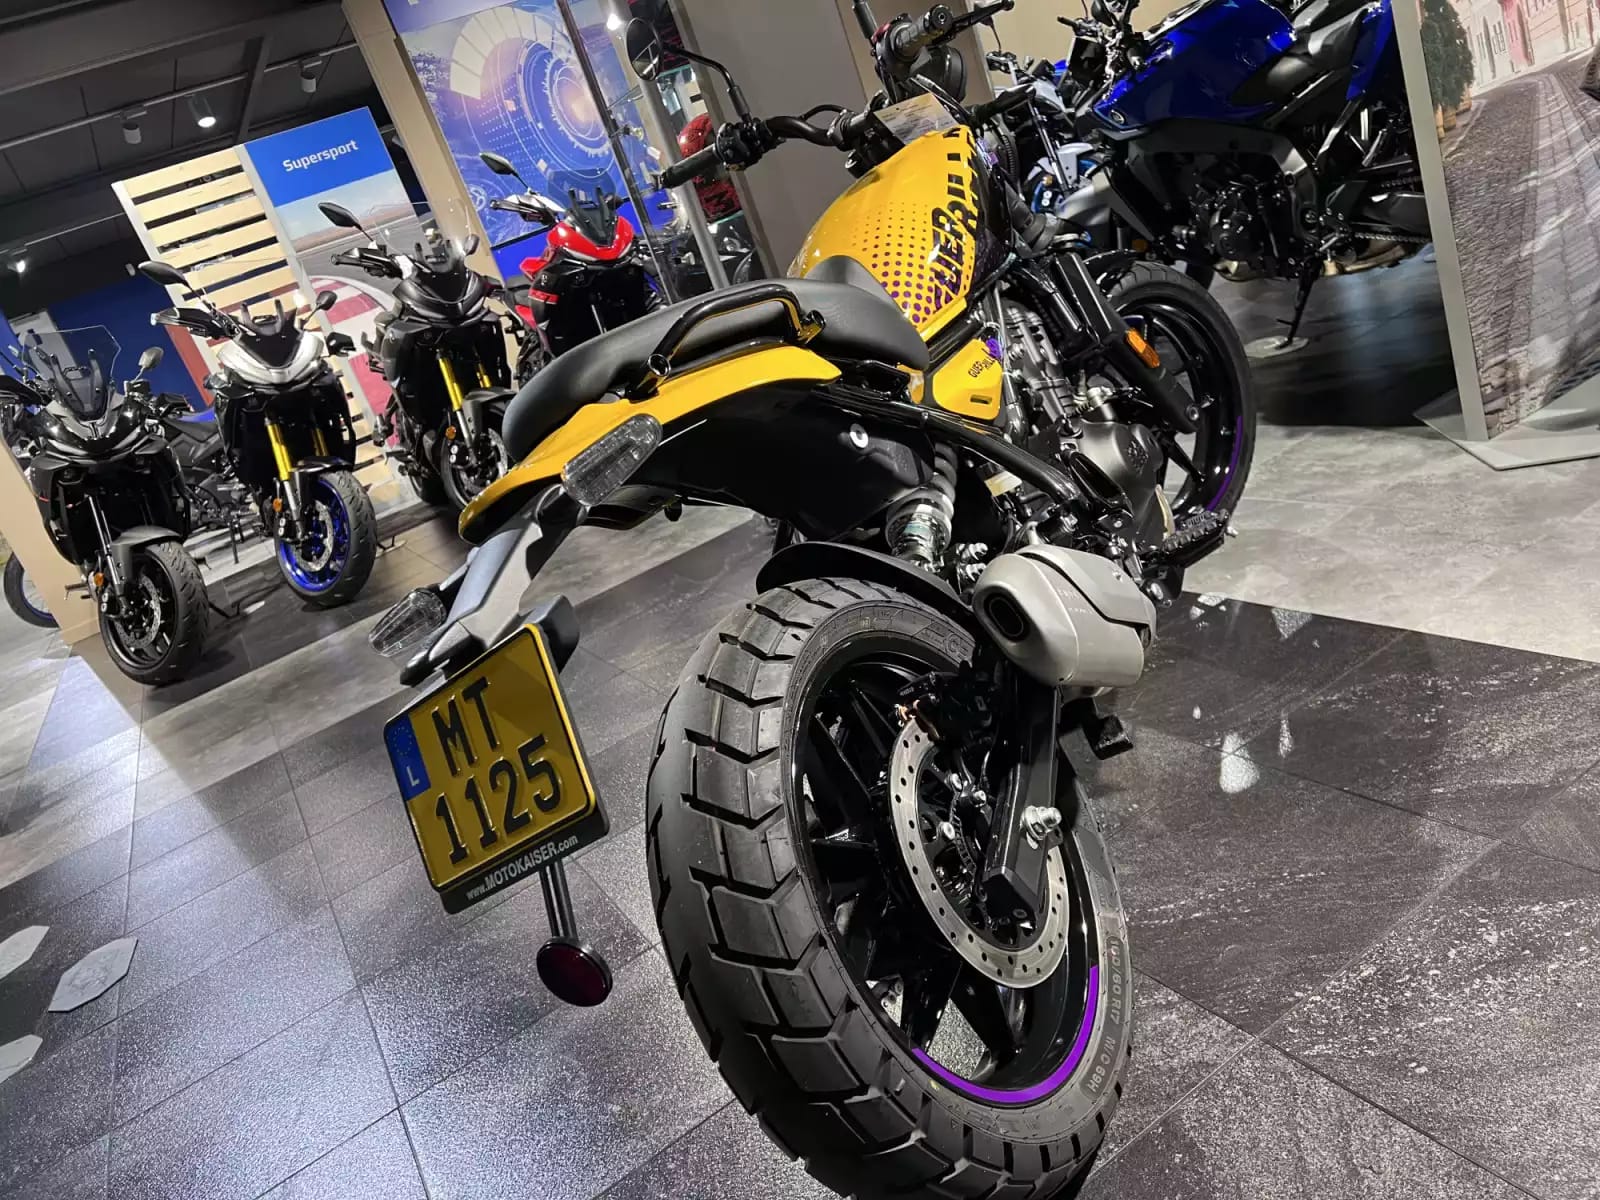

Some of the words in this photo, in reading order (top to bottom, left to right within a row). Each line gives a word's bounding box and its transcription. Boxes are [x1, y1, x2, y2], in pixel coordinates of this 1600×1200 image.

[282, 139, 359, 172] Supersport
[431, 676, 500, 778] MT
[405, 765, 420, 788] L
[435, 733, 562, 866] 1125
[465, 835, 579, 901] www.MOTOKAISER.com
[1110, 999, 1122, 1025] R17
[1100, 1035, 1116, 1065] M/C
[1087, 1064, 1106, 1093] 69H
